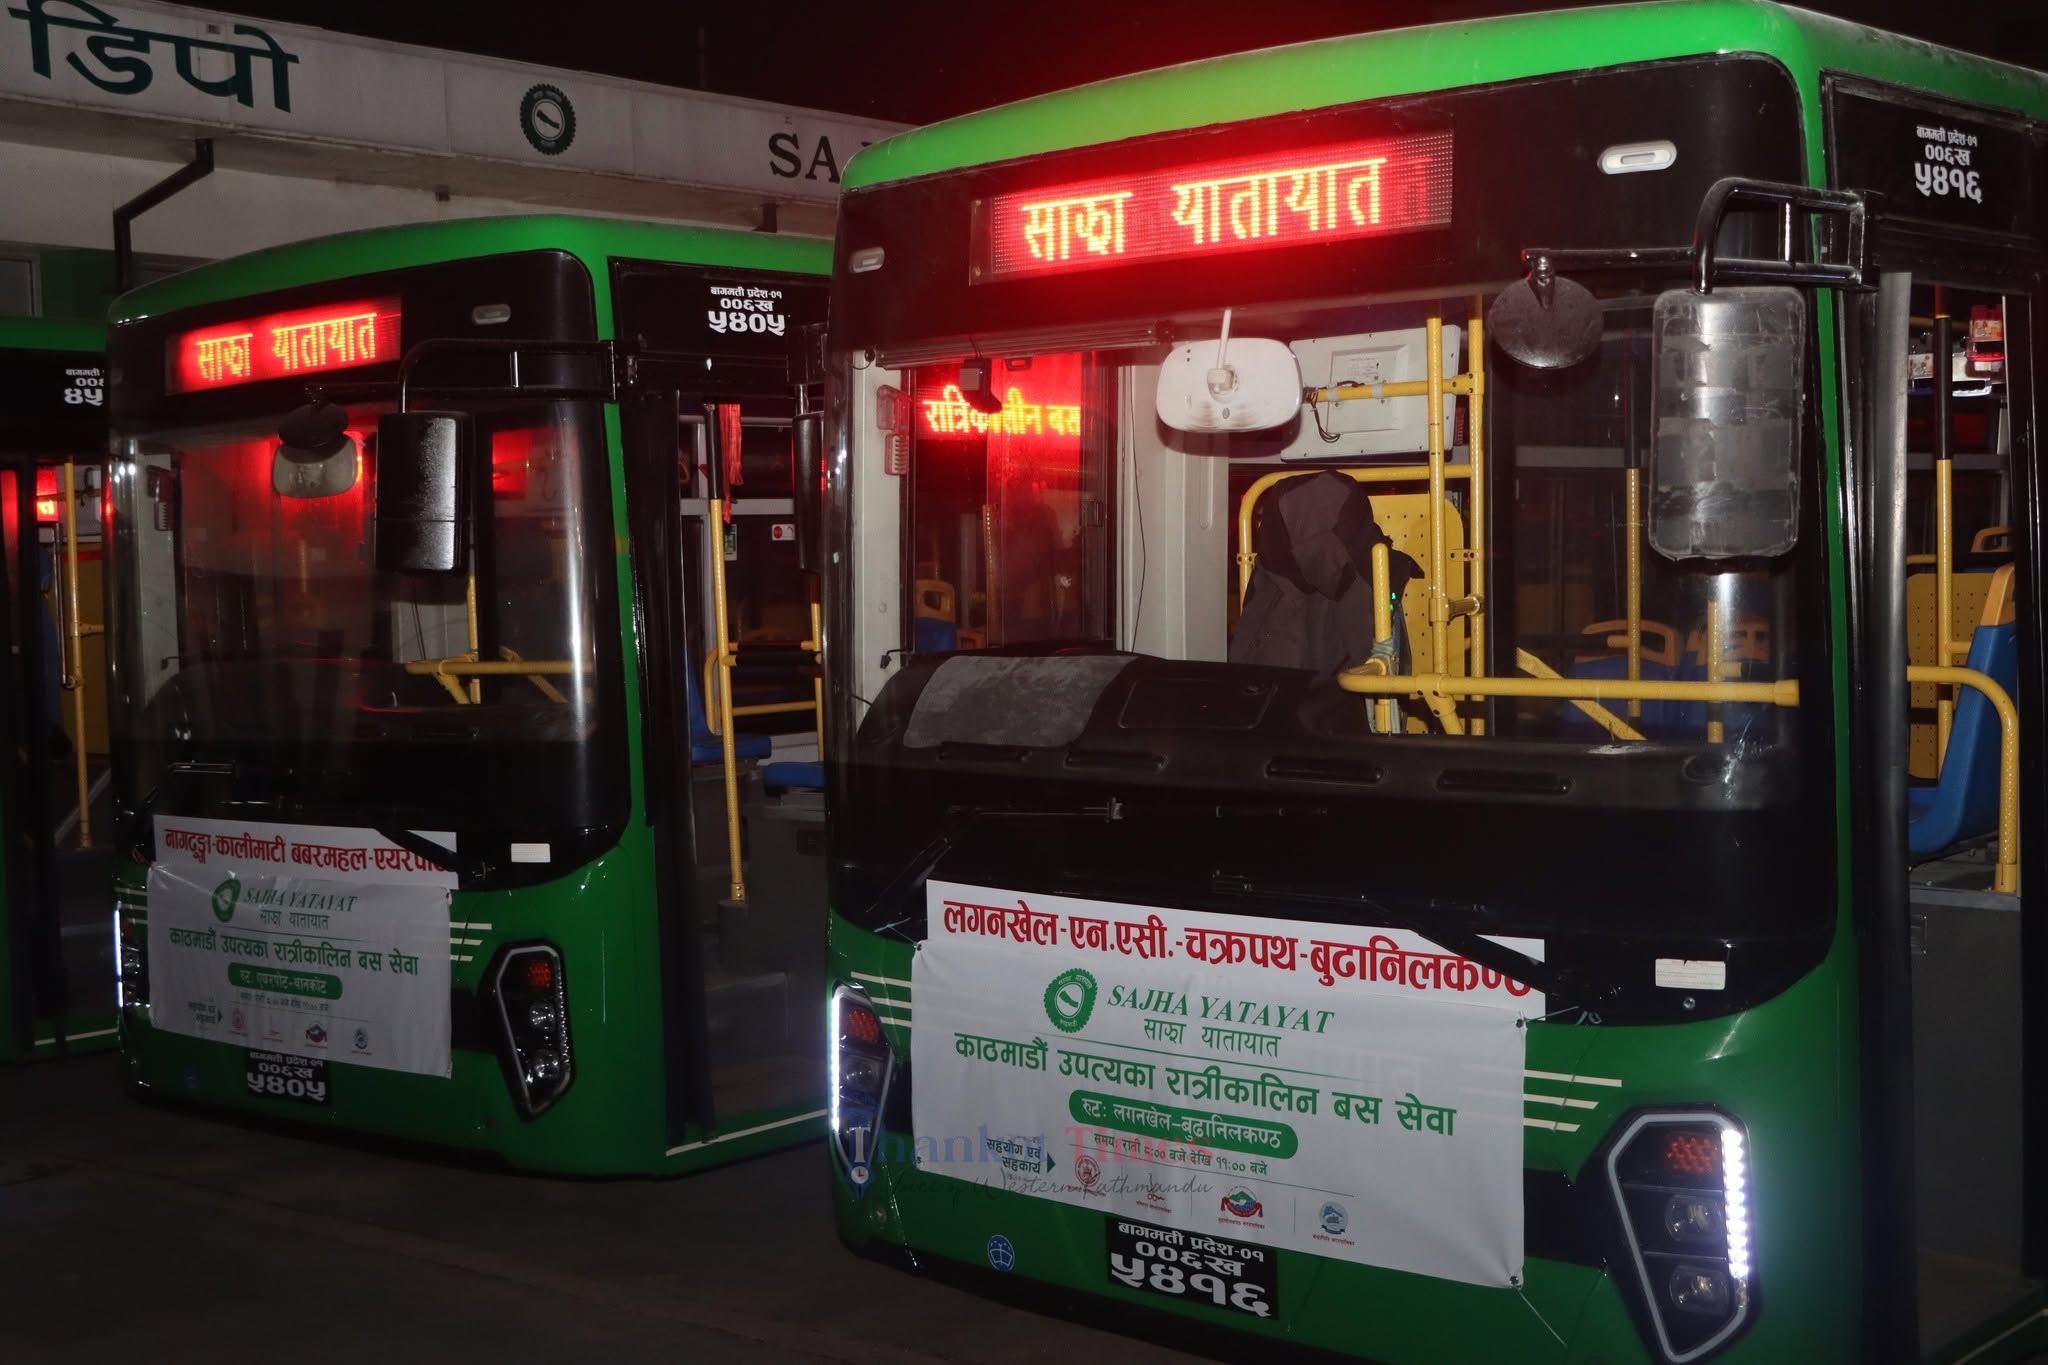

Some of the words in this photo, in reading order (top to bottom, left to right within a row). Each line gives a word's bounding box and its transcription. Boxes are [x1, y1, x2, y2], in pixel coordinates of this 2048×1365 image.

[8, 0, 299, 112] डिपो
[1916, 125, 1946, 142] बागमती
[768, 132, 873, 184] SA
[1925, 144, 1971, 166] ००६ख
[1915, 162, 1982, 204] ५४१६
[1021, 191, 1133, 261] साझा
[1171, 156, 1387, 244] यातायात
[710, 286, 745, 297] बागमती
[720, 298, 774, 312] ००६ख
[708, 311, 786, 336] ५४०५
[196, 333, 253, 381] साझा
[272, 313, 377, 370] यातायात
[220, 935, 270, 958] उपत्यका
[358, 950, 382, 972] बस
[389, 948, 419, 976] सेवा
[1106, 984, 1188, 1017] SAJHA
[1200, 995, 1335, 1034] YATAYAT
[1143, 1018, 1187, 1045] साझा
[1201, 1025, 1282, 1058] यातायात
[246, 1071, 327, 1102] ५४०५
[954, 1032, 1048, 1071] काठमाडौं
[1057, 1049, 1156, 1090] उपत्यका
[1165, 1065, 1319, 1115] रात्रीकालिन
[1332, 1091, 1383, 1125] बस
[1395, 1093, 1457, 1136] सेवा
[986, 1138, 1023, 1156] सहयोग
[1169, 1147, 1186, 1163] बजे
[1190, 1150, 1212, 1167] देखि
[1250, 1160, 1268, 1176] बजे
[1118, 1222, 1185, 1246] बागमती
[1135, 1241, 1246, 1277] ००६ख
[1110, 1251, 1272, 1318] ५४१६
